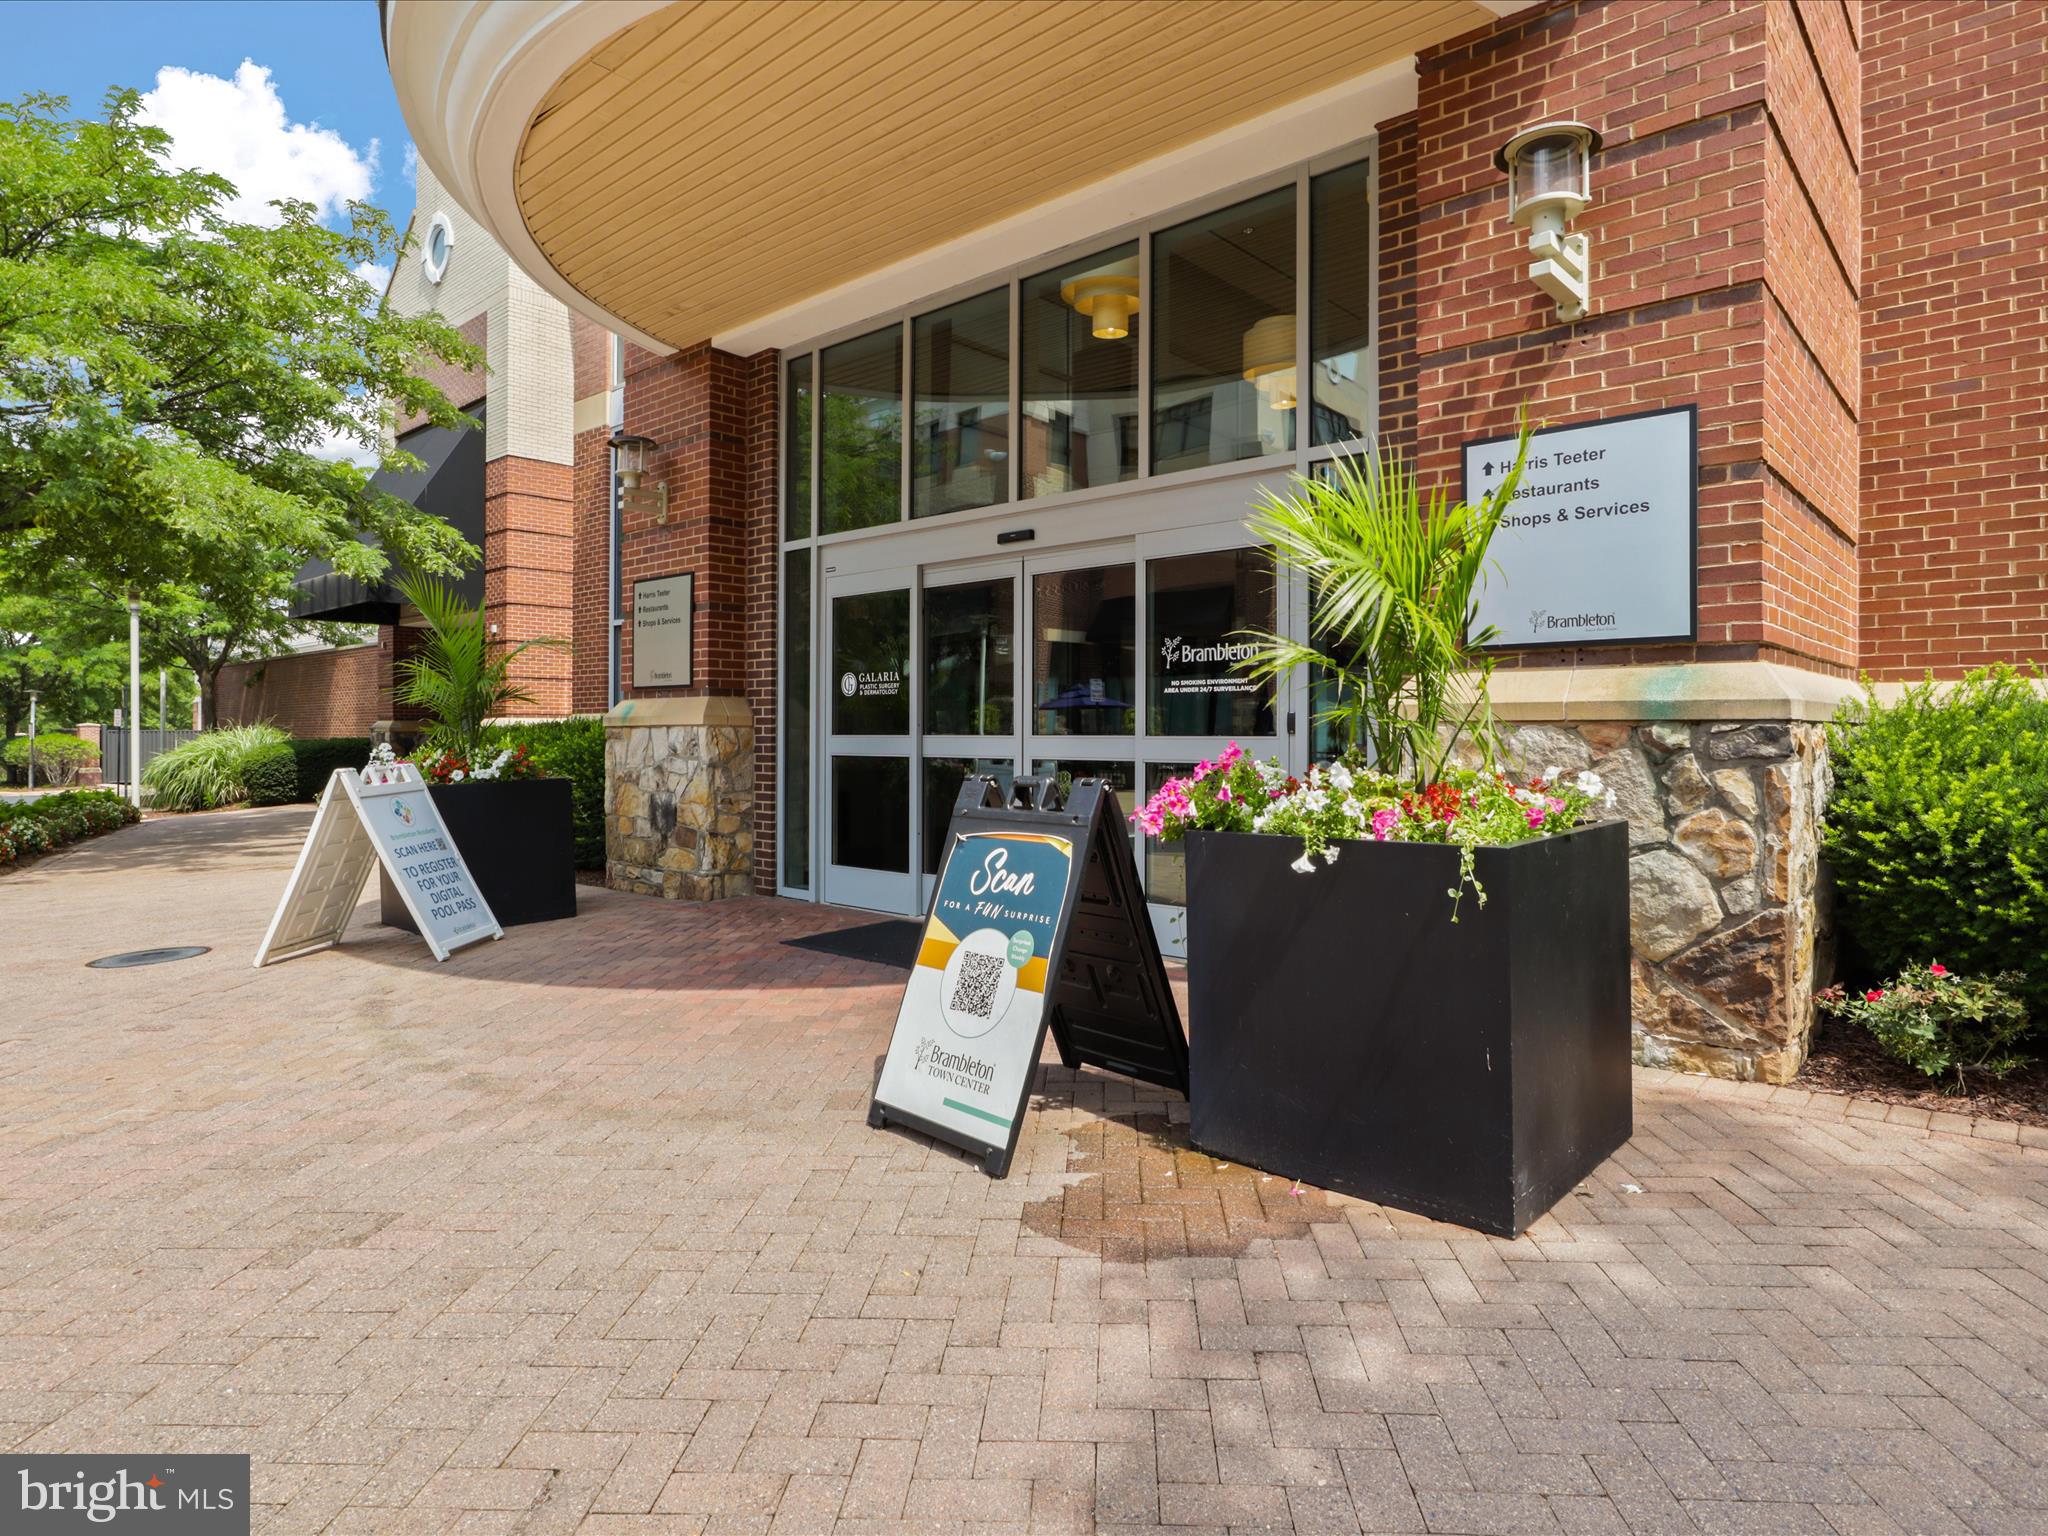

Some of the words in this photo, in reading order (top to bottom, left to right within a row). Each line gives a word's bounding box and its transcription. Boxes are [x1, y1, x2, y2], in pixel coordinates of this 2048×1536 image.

[1500, 456, 1548, 474] Hris
[1554, 449, 1606, 466] Teeter
[1510, 478, 1600, 500] estaurants
[1500, 513, 1551, 528] Shops
[1556, 508, 1569, 522] &
[1574, 501, 1650, 520] Services
[643, 605, 669, 613] Restaurants
[661, 617, 681, 625] Services
[1547, 613, 1615, 628] Brambleton
[1181, 642, 1259, 663] Brambleton
[858, 671, 900, 682] GALARIA
[1206, 677, 1248, 685] ENVIRONMENT
[394, 844, 419, 859] SCAN
[417, 840, 439, 854] HERE
[402, 866, 419, 879] TO
[418, 857, 459, 875] REGISTER
[970, 847, 1035, 896] Scan
[416, 879, 438, 892] FOR
[436, 871, 461, 887] YOUR
[430, 886, 465, 905] DIGITAL
[431, 903, 458, 920] POOL
[455, 898, 477, 913] PASS
[943, 900, 961, 909] FOR
[964, 903, 971, 911] A
[973, 901, 1004, 920] FUN
[1004, 909, 1052, 925] SURPRISE
[930, 1045, 995, 1082] Brambleton
[928, 1065, 955, 1083] TOWN
[954, 1074, 991, 1096] CENTER
